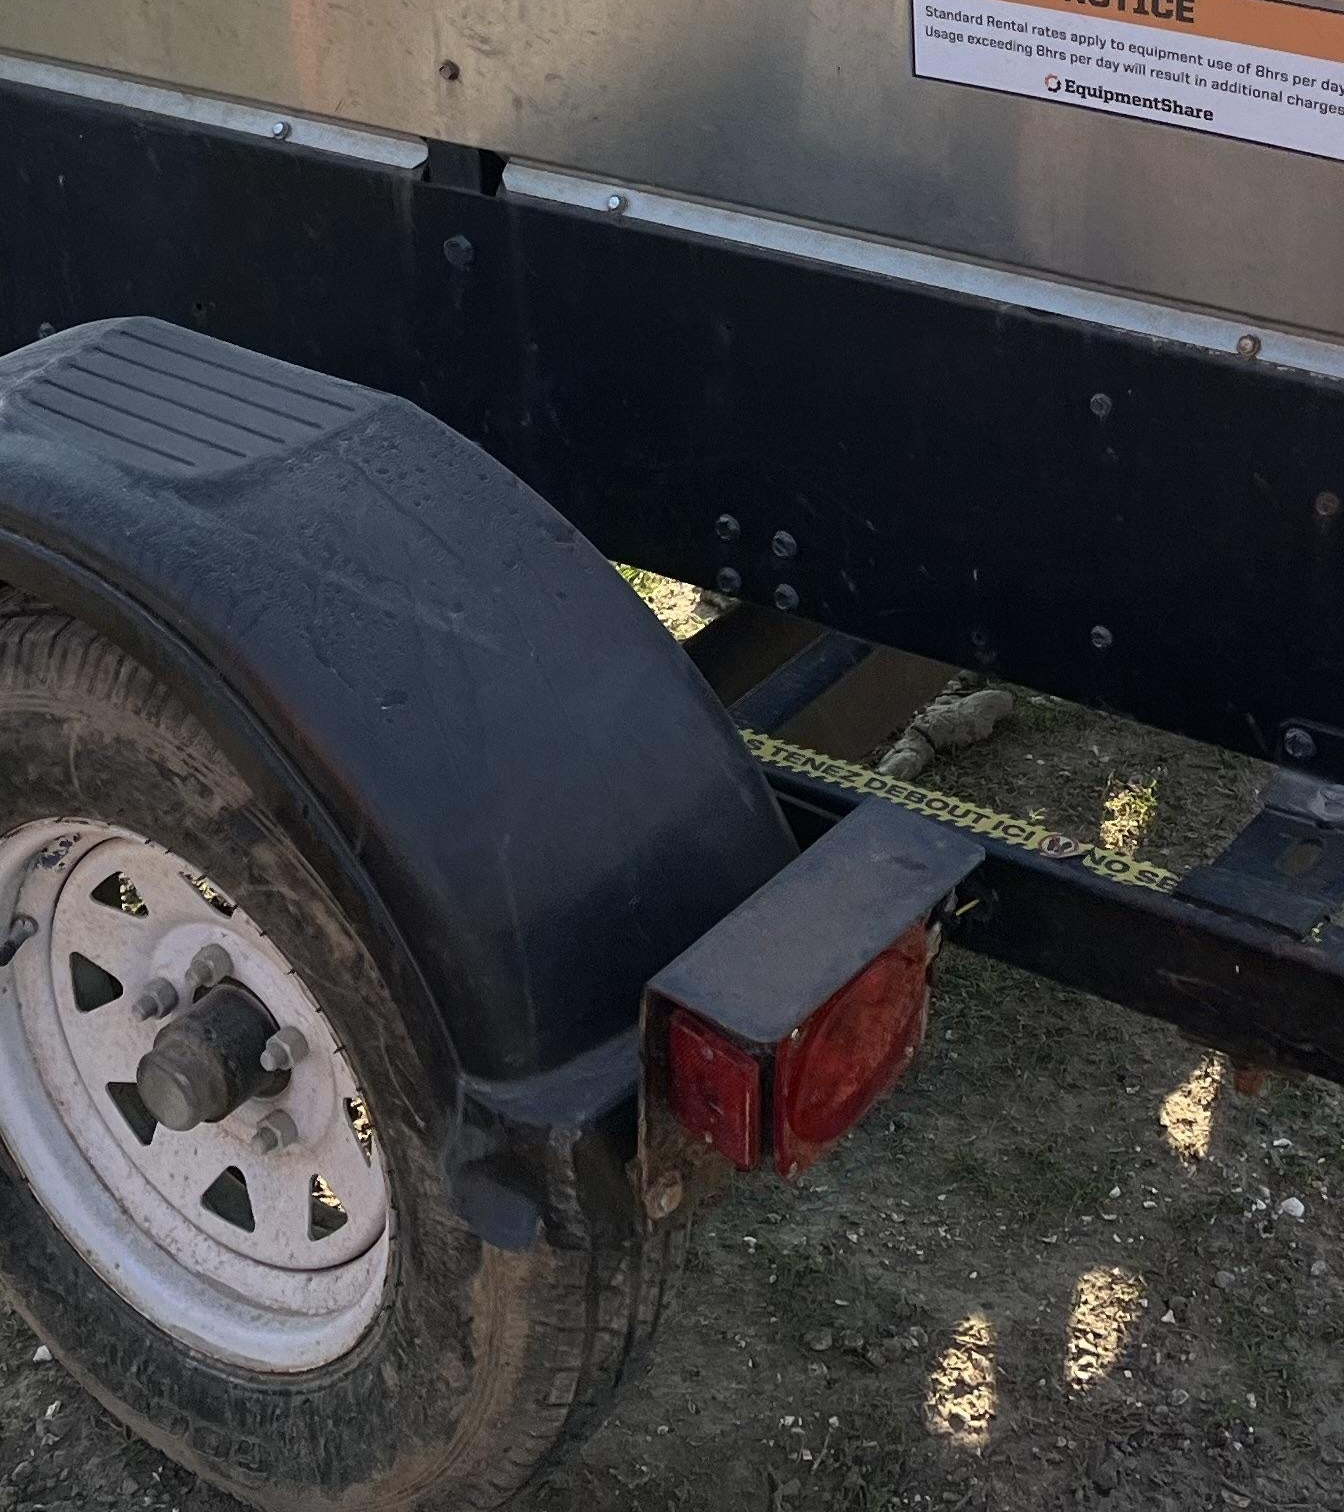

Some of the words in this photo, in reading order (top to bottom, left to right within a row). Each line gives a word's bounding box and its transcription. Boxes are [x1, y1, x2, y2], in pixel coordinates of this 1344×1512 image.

[925, 5, 983, 26] Standard
[986, 15, 1028, 33] Rental
[1031, 25, 1067, 41] rates
[1070, 32, 1106, 50] apply
[1110, 38, 1125, 52] to
[1128, 44, 1203, 67] equipment
[1207, 57, 1233, 72] use
[1236, 61, 1252, 75] of
[1255, 64, 1289, 83] 8hrs
[1292, 74, 1317, 89] per
[925, 25, 963, 44] Usage
[967, 34, 1033, 57] exceeding
[1036, 44, 1067, 61] 8hrs
[1070, 52, 1092, 66] per
[1096, 56, 1120, 73] day
[1123, 63, 1146, 77] will
[1150, 67, 1191, 85] result
[1194, 74, 1207, 88] in
[1211, 78, 1283, 103] additional
[1064, 78, 1214, 122] EquipmentShare
[770, 746, 869, 784] TENEZ
[863, 775, 990, 830] DEBOUT
[993, 817, 1036, 843] ICI
[1084, 848, 1132, 876] NO
